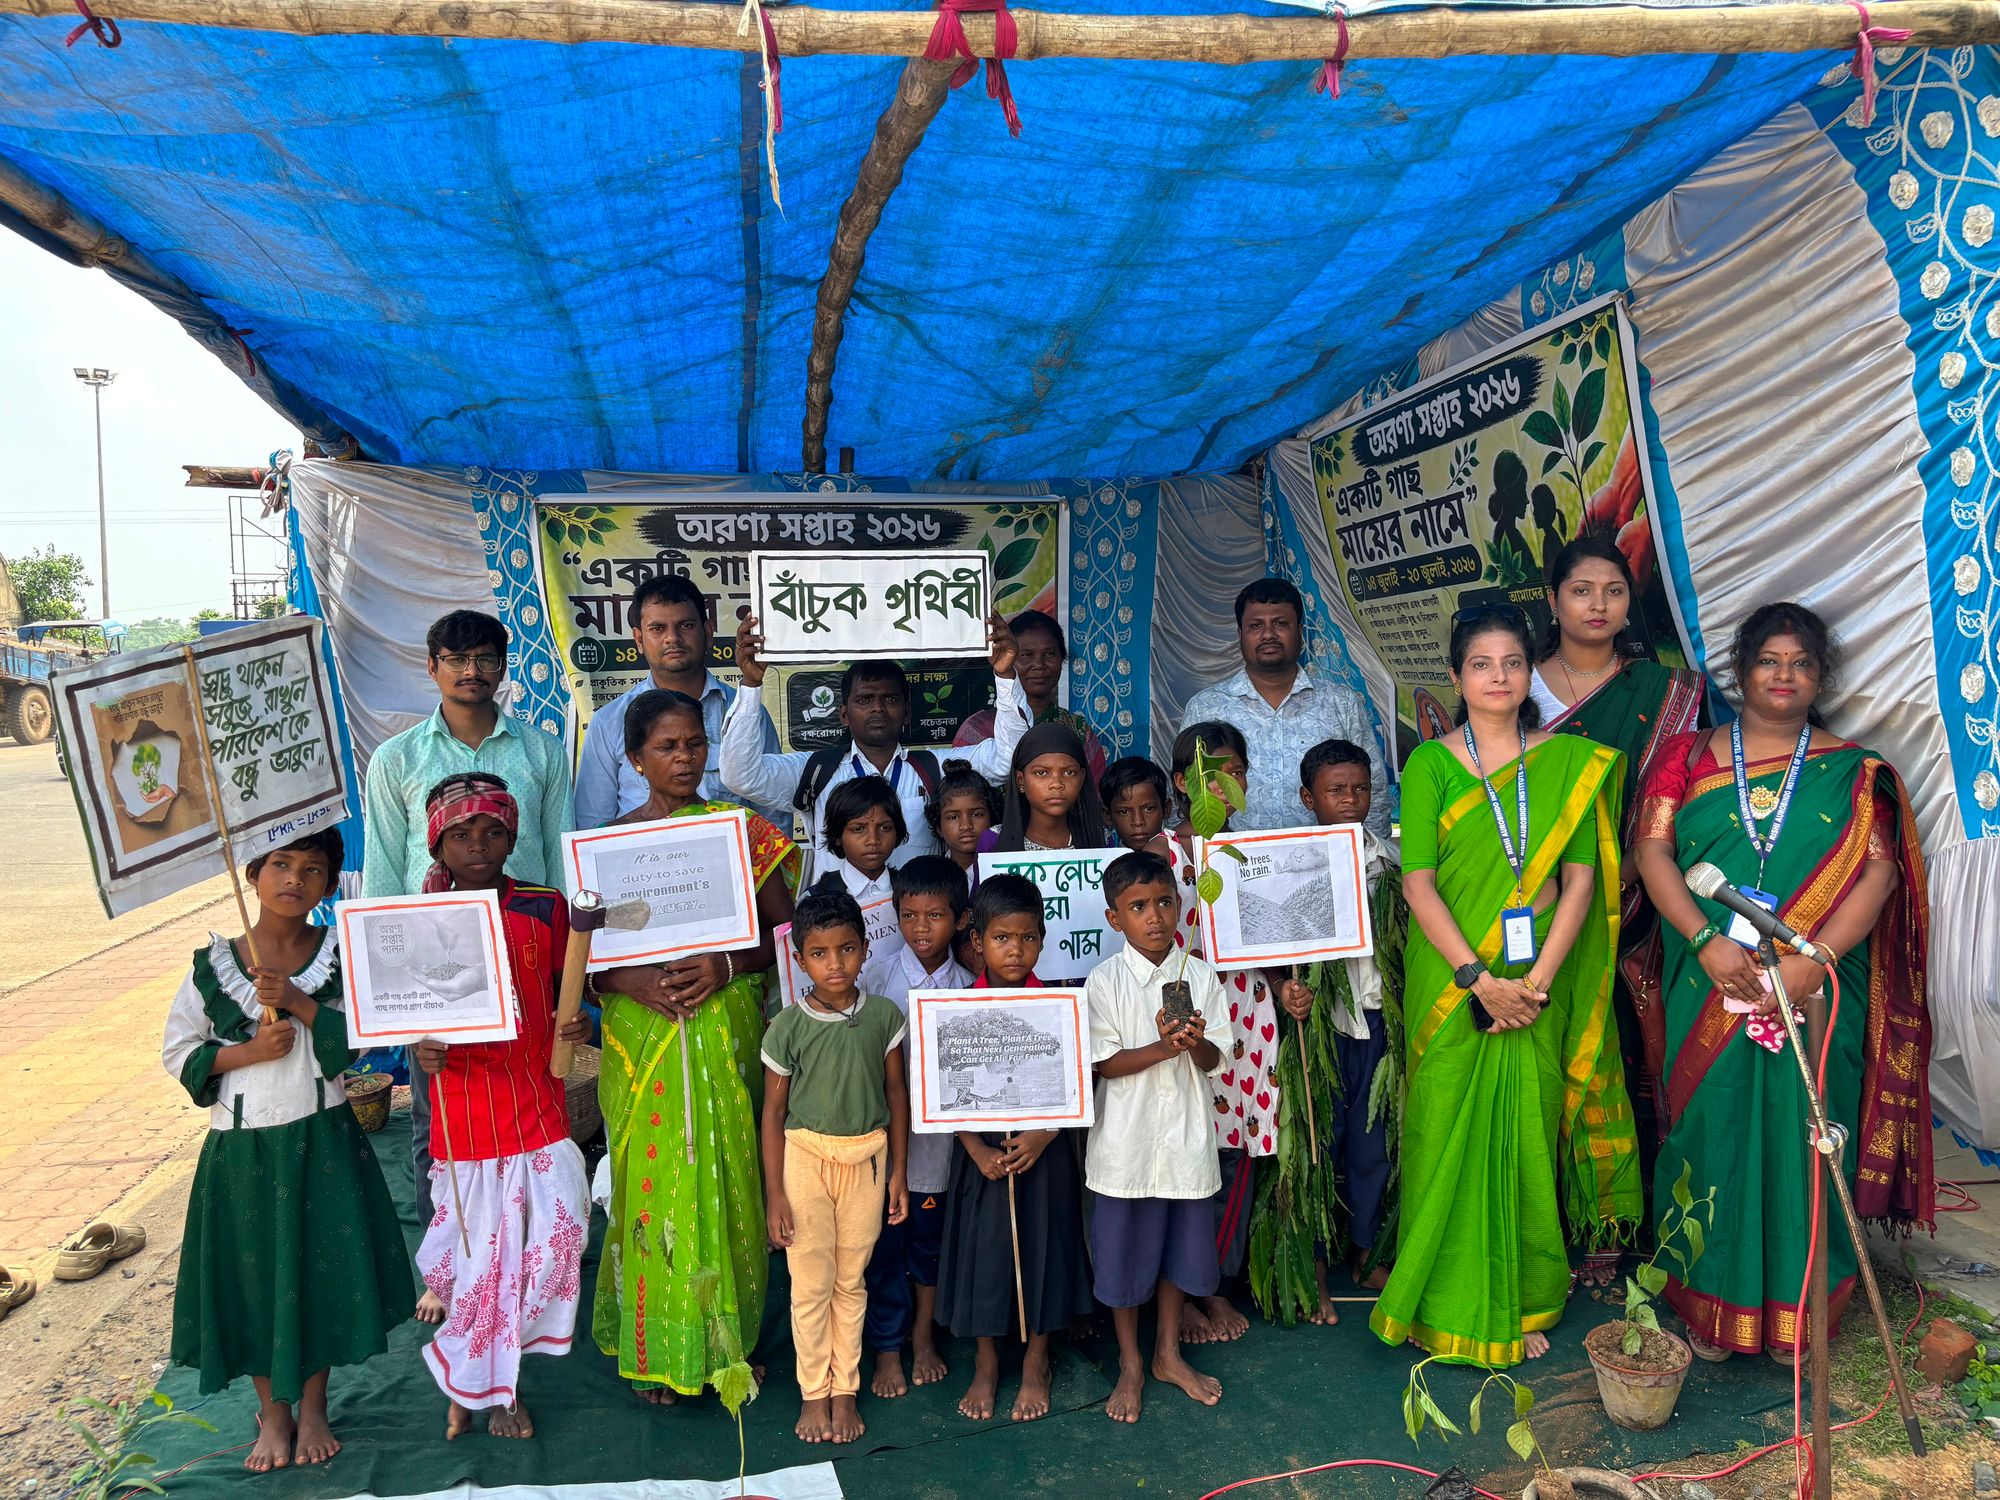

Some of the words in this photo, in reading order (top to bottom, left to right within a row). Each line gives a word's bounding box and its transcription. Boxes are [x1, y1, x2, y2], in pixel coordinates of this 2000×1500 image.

[1366, 409, 1415, 457] অরণ্য
[1415, 389, 1464, 438] সপ্তাহ
[1467, 368, 1520, 418] ২০২৬
[1326, 468, 1382, 516] “একটি
[1386, 461, 1424, 500] গাছ
[675, 512, 771, 544] অরণ্য
[778, 512, 856, 545] সপ্তাহ
[867, 513, 941, 542] ২০২৬
[1336, 510, 1407, 565] মায়ের
[1404, 485, 1478, 548] নামে”
[702, 555, 750, 586] গা
[1365, 575, 1378, 591] ১৪
[1376, 567, 1400, 593] জুলাই
[1408, 568, 1420, 583] ২০
[1451, 556, 1476, 577] ২০২৬
[768, 569, 868, 634] বাঁচুক
[884, 567, 982, 634] পৃথিবী
[1508, 588, 1544, 603] আমাদের
[615, 649, 638, 663] ১৪
[712, 645, 733, 660] ২০
[236, 650, 289, 689] থাকুন
[923, 672, 949, 682] লক্ষ্য
[204, 695, 254, 732] সবুজ
[263, 675, 310, 715] রাখুন
[920, 717, 958, 727] সচেতনতা
[801, 729, 843, 741] বৃক্ষরোপণ
[930, 727, 947, 740] সৃষ্টি
[1735, 763, 1745, 788] INSTITUTE
[1769, 821, 1780, 840] RISHI
[1775, 790, 1792, 821] AUROBINDO
[1786, 764, 1800, 791] INSTITUTE
[1796, 736, 1807, 758] TEACHER
[1738, 787, 1751, 819] AUROBINDO
[1493, 802, 1509, 837] AUROBINDO
[1519, 802, 1528, 838] AUROBINDO
[1746, 820, 1756, 838] RISHI
[1503, 838, 1514, 855] RISHI
[634, 853, 648, 865] It
[649, 853, 661, 863] is
[666, 851, 690, 861] our
[1250, 855, 1272, 865] trees.
[622, 872, 653, 884] duty
[657, 871, 671, 879] to
[674, 866, 705, 877] save
[1239, 867, 1251, 878] No
[1252, 864, 1272, 877] rain.
[620, 880, 710, 899] environment's
[948, 1037, 972, 1046] Plant
[972, 1037, 978, 1045] A
[1002, 1034, 1025, 1044] Plant
[950, 1047, 960, 1055] So
[962, 1046, 982, 1055] That
[983, 1045, 1002, 1054] Next
[1003, 1043, 1052, 1053] Generation
[979, 1055, 993, 1063] Get
